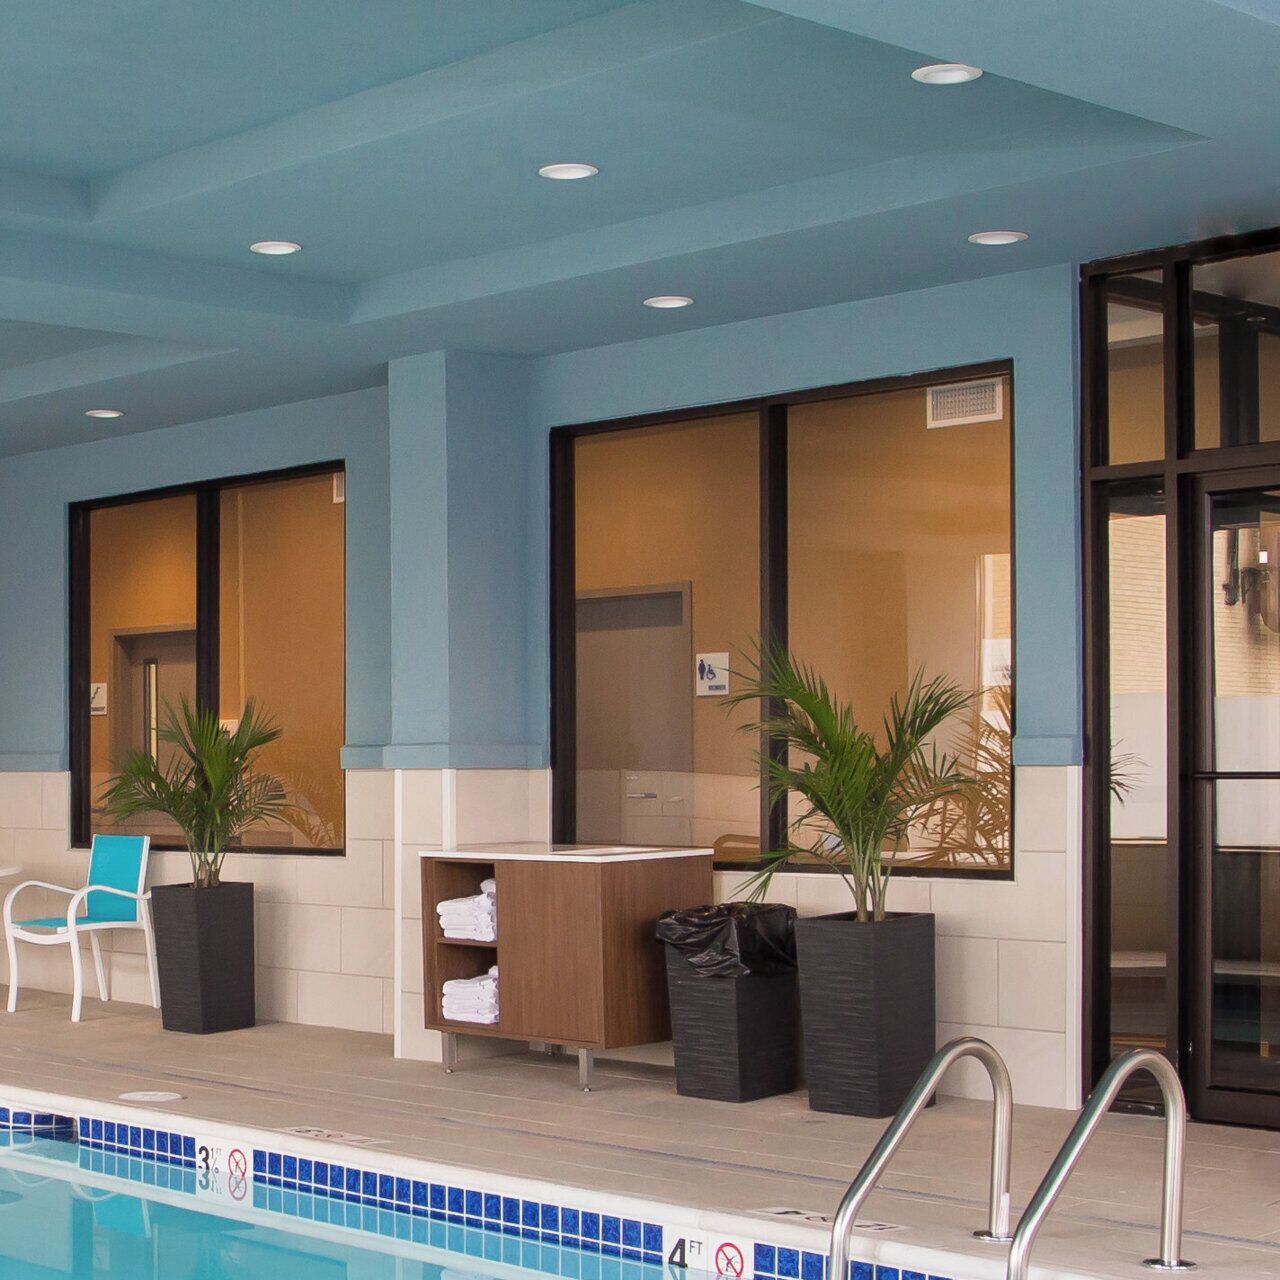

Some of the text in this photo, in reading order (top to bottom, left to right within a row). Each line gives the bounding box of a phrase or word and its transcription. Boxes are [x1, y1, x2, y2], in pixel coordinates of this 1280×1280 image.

[198, 1146, 210, 1171] 3
[668, 1237, 704, 1268] 4 FT
